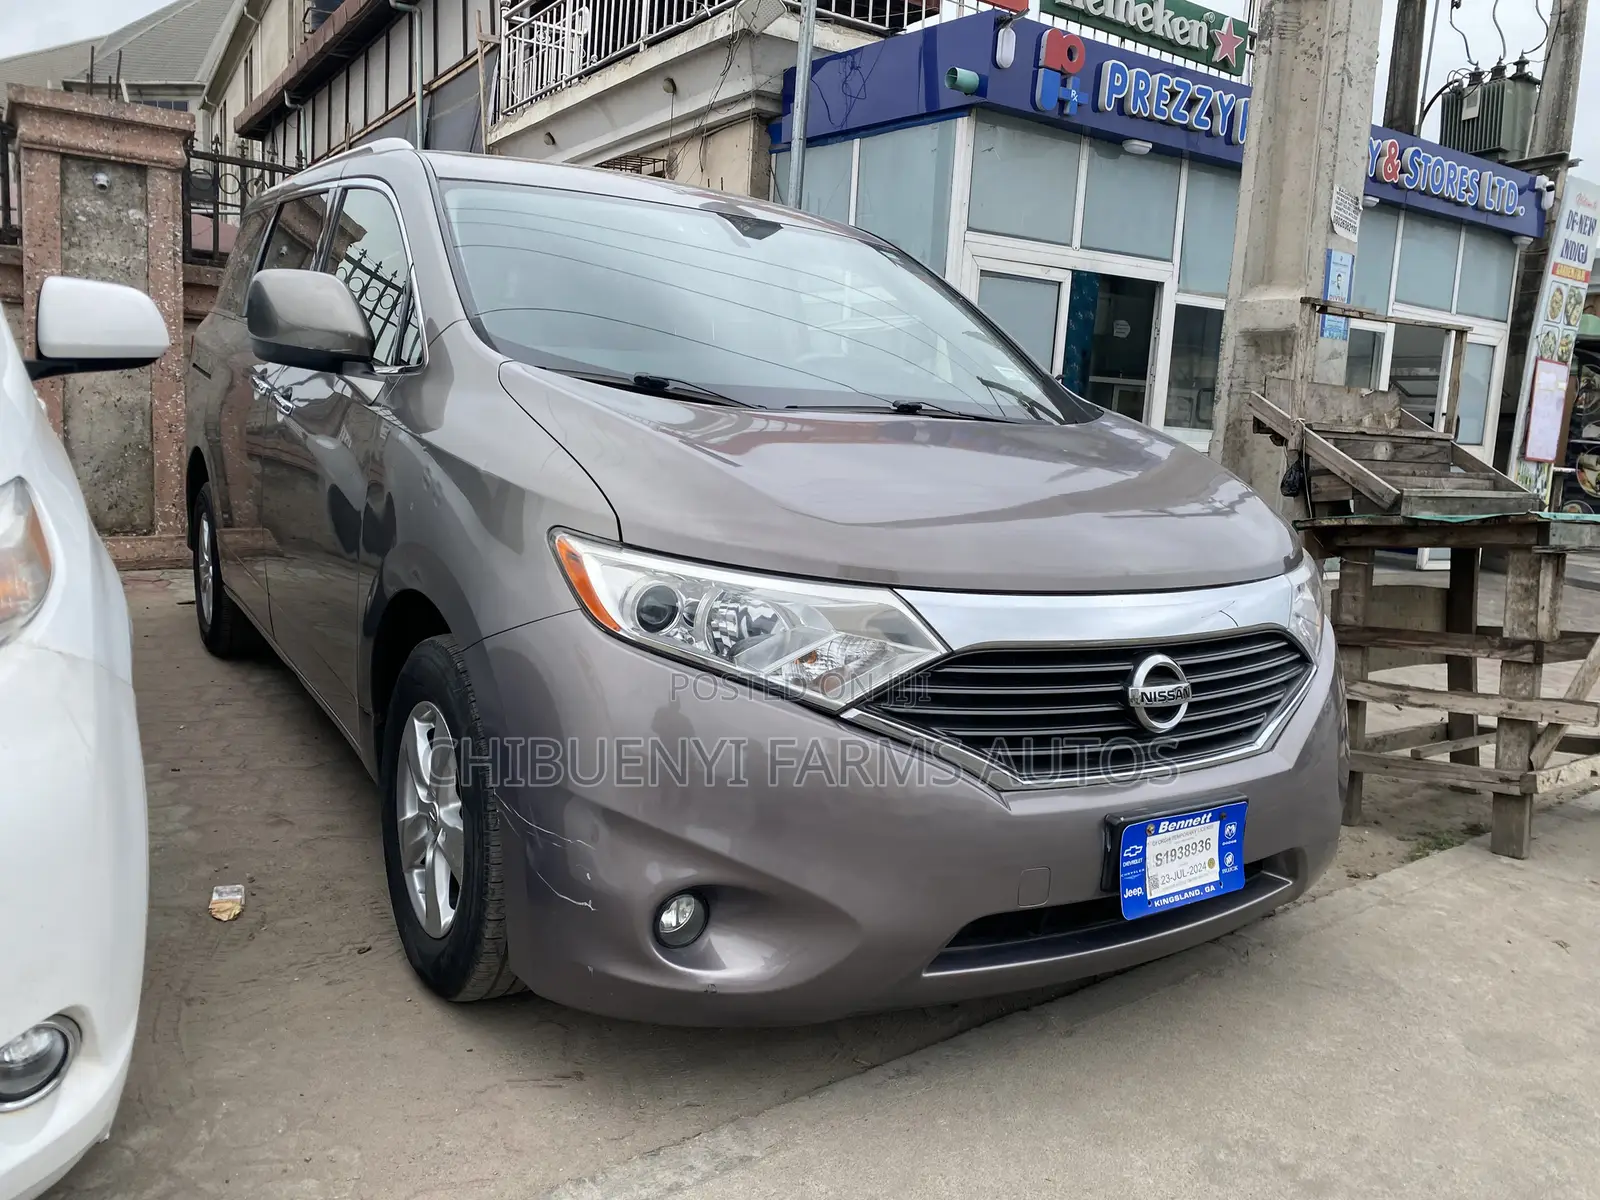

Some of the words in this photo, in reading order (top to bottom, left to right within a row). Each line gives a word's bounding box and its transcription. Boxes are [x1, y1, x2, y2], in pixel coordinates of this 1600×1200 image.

[1099, 59, 1236, 137] PREZZY
[1382, 138, 1401, 183] &
[1402, 146, 1480, 208] STORES
[1481, 170, 1526, 217] LTD.
[1140, 686, 1191, 704] NISSAN
[1158, 812, 1213, 834] Bennett
[1155, 837, 1212, 868] S1938936
[1160, 861, 1207, 886] 23-JUL-2024
[1123, 886, 1143, 898] Jeep
[1204, 884, 1216, 893] GA
